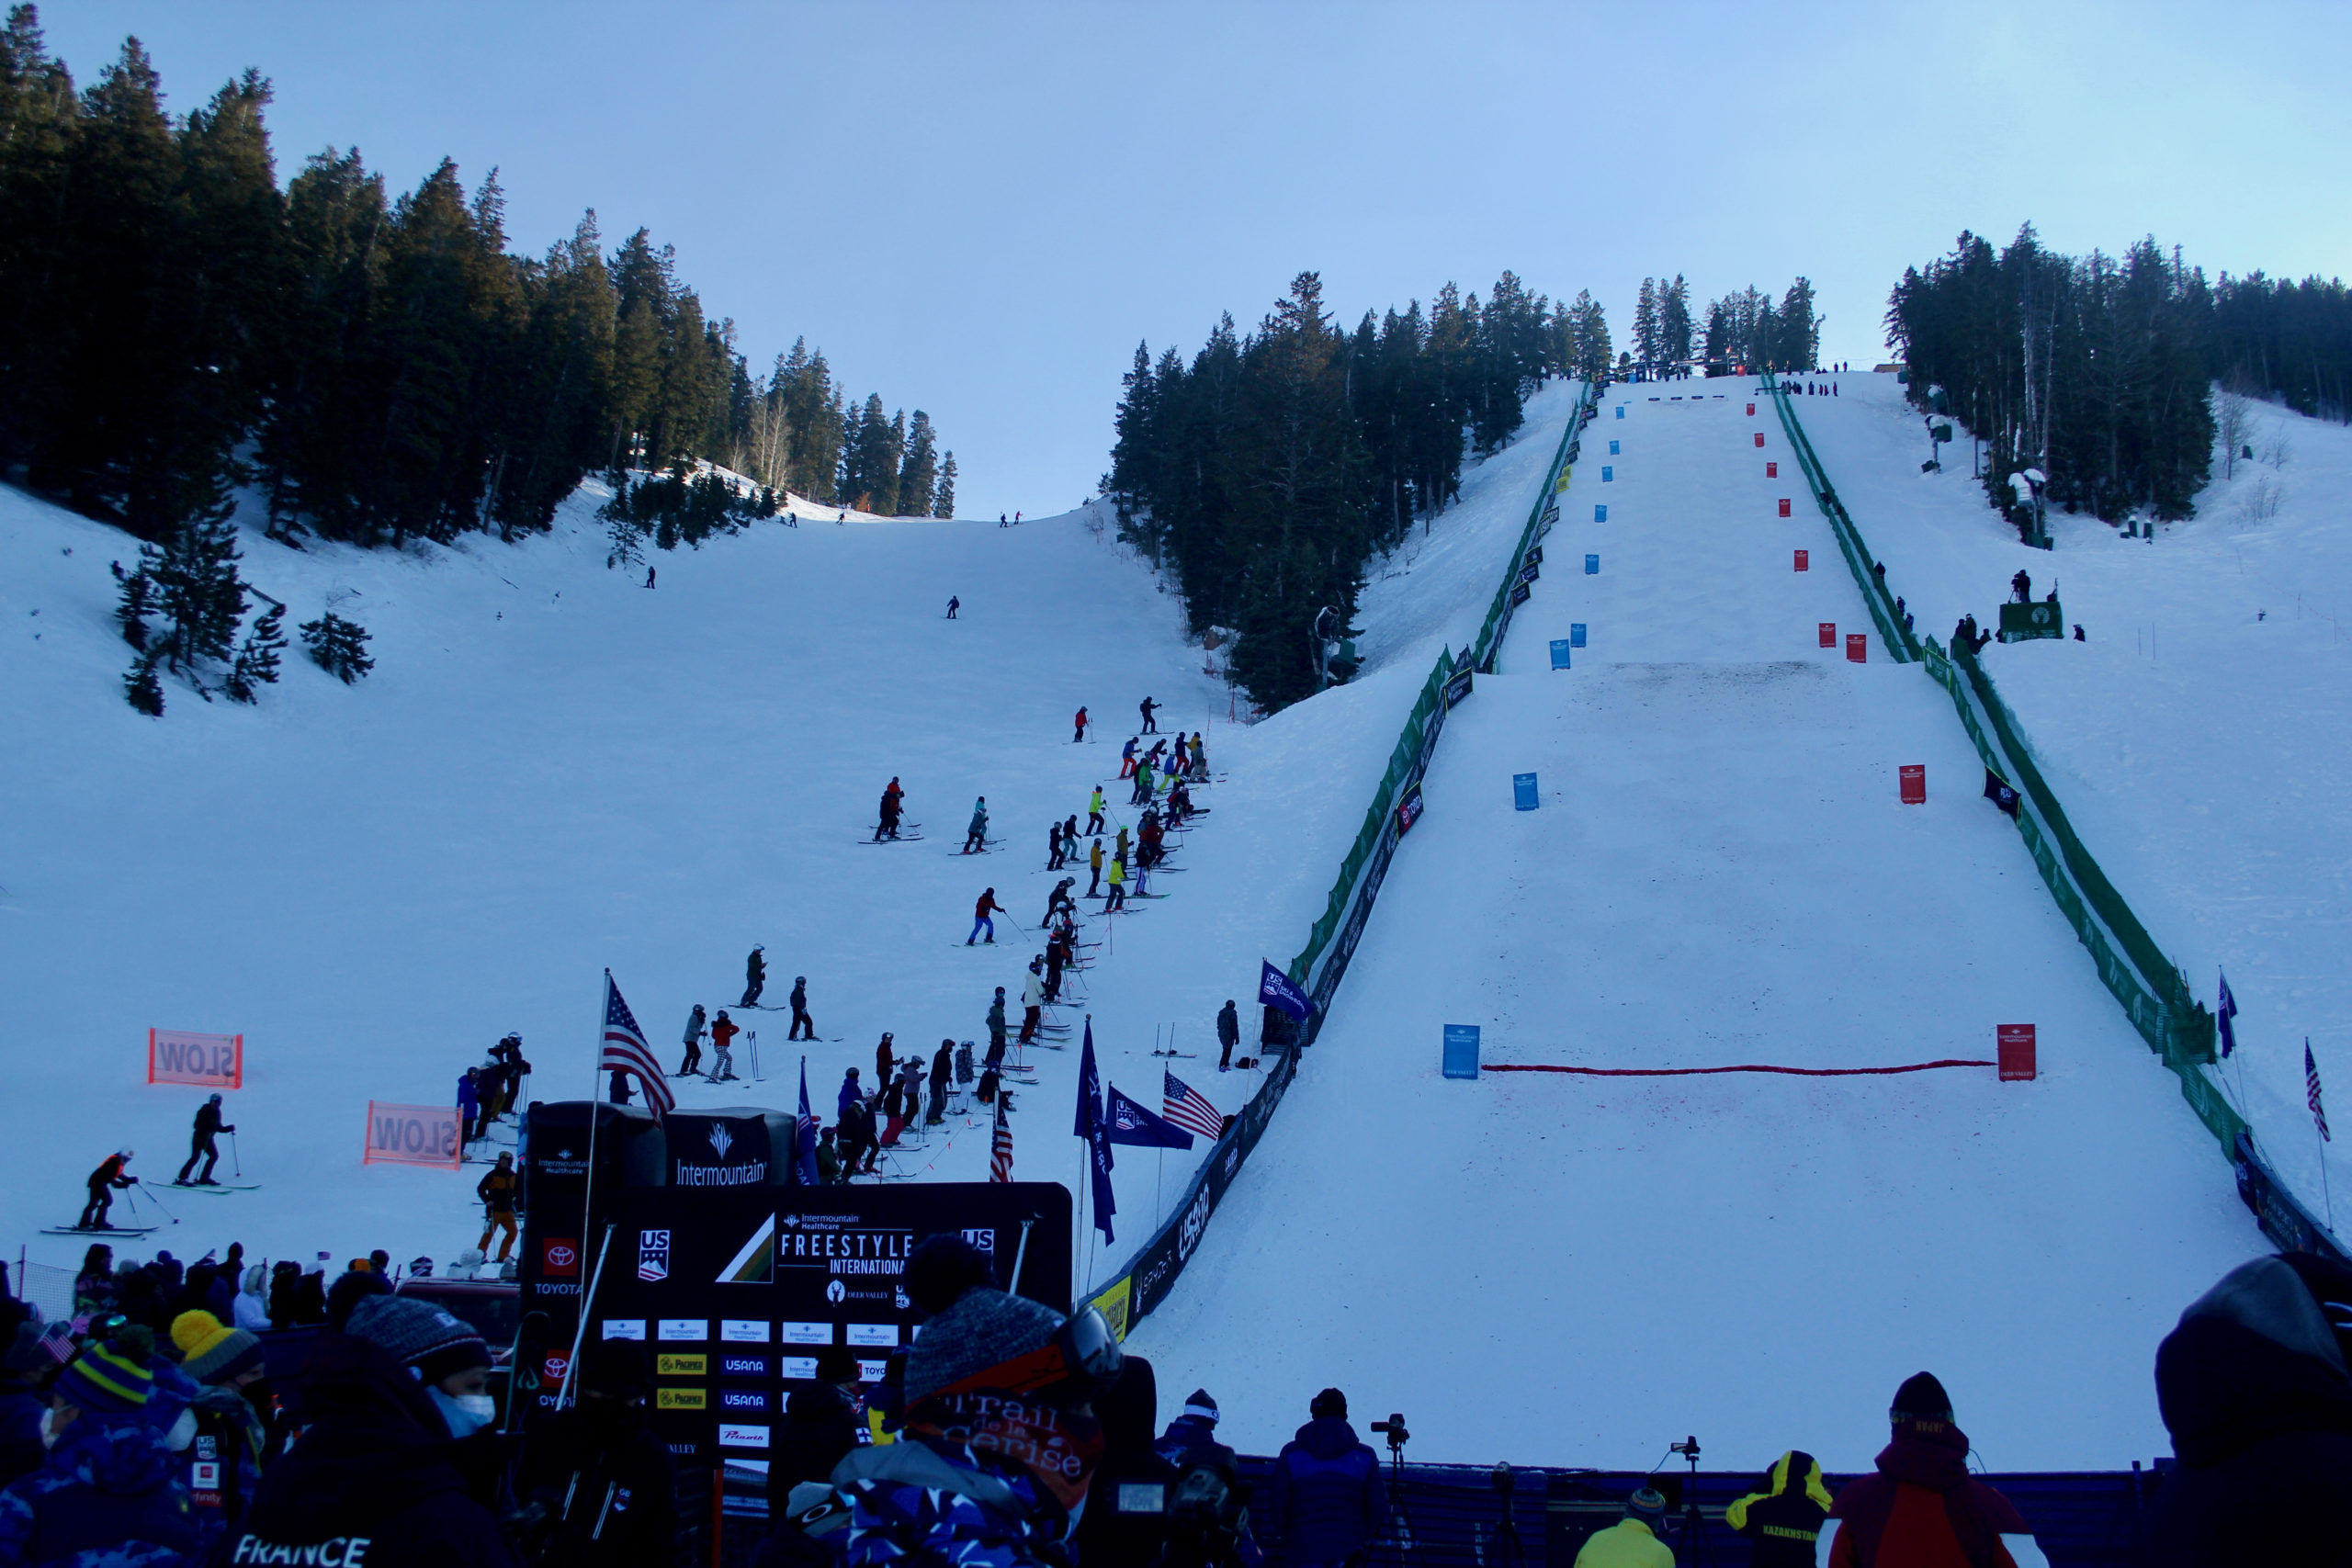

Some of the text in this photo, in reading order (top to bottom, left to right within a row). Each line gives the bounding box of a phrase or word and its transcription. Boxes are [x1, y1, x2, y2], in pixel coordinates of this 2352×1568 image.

[1268, 974, 1282, 984] US
[538, 1158, 590, 1168] Intermountai
[545, 1167, 584, 1176] Healthcare
[676, 1158, 766, 1186] Intermountain
[802, 1213, 858, 1224] Intermountain
[1178, 1182, 1210, 1261] USANA
[801, 1223, 840, 1231] Healthcare
[641, 1233, 669, 1248] US
[781, 1234, 913, 1258] FREESTYLE
[830, 1258, 905, 1275] INTERNATIONA
[847, 1291, 889, 1300] DEER VALLEY
[725, 1359, 763, 1372] USANA
[865, 1367, 887, 1375] TOYO
[725, 1393, 763, 1406] USANA
[618, 1487, 631, 1498] GB
